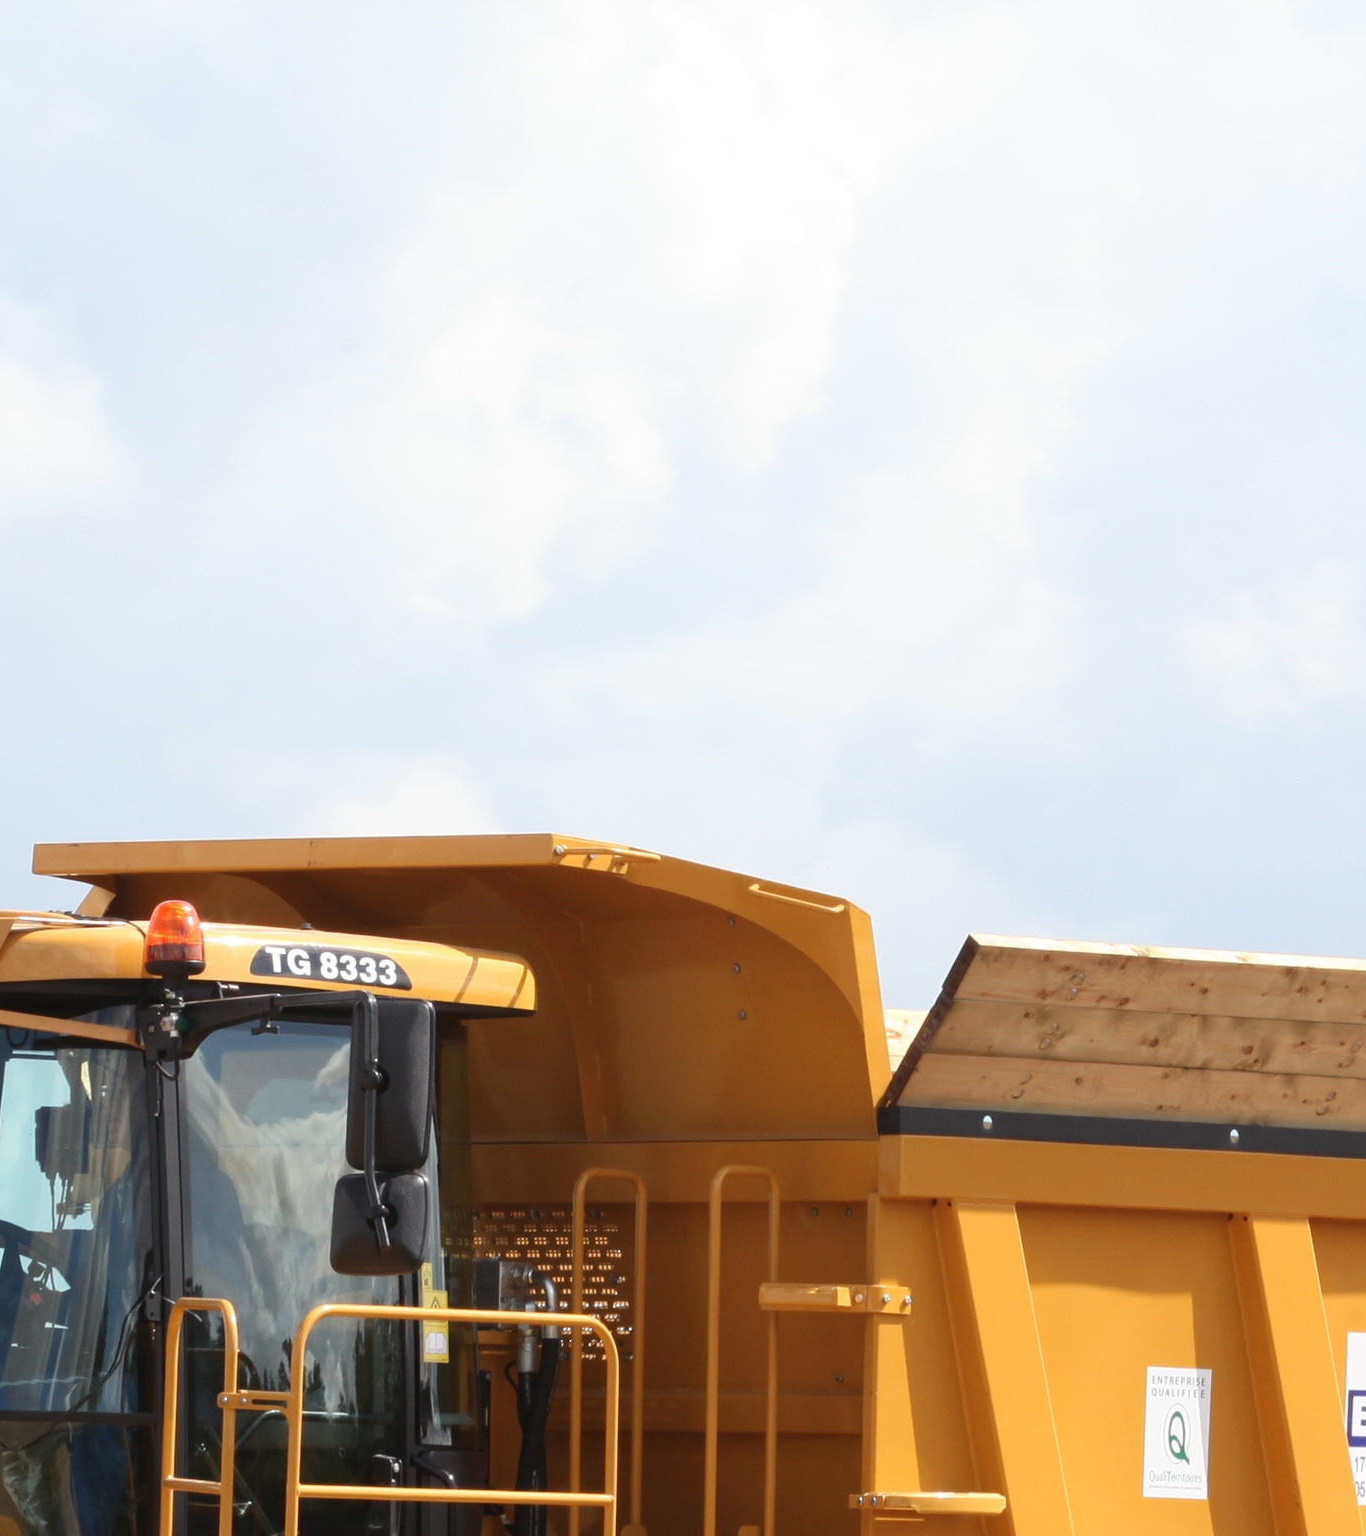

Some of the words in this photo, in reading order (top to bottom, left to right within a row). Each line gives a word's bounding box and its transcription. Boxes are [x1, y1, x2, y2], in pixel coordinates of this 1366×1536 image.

[265, 946, 311, 976] TG
[319, 951, 397, 986] 8333
[1151, 1375, 1206, 1387] ENTREPRISE
[1354, 1456, 1366, 1473] 17
[1148, 1469, 1203, 1484] QualiTerritoires
